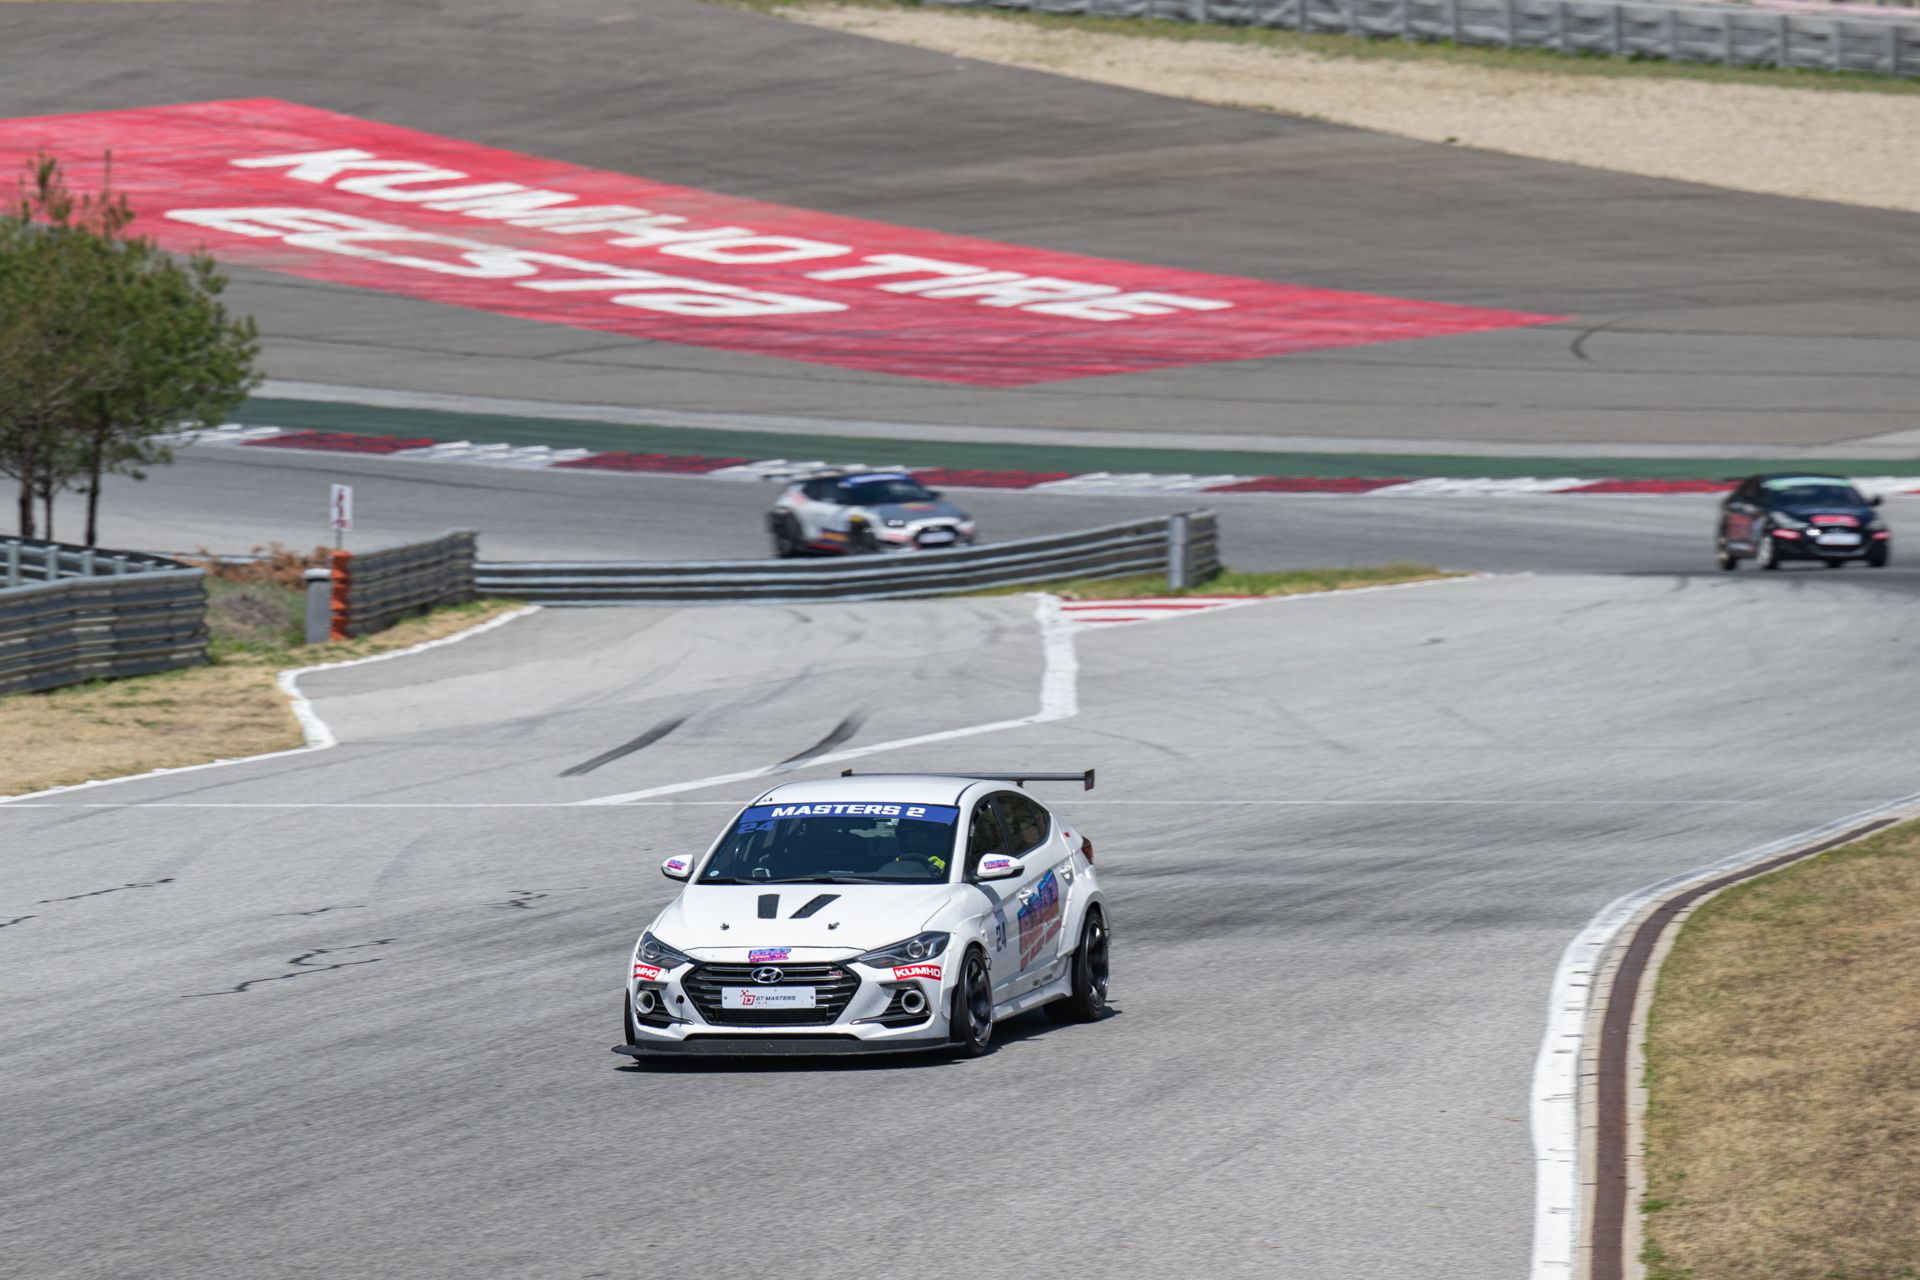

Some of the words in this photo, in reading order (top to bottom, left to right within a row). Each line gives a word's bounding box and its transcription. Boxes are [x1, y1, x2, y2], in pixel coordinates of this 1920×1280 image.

[228, 148, 853, 264] KUMHO
[804, 253, 1235, 321] TIRE
[771, 804, 902, 818] MASTERS
[906, 806, 927, 818] 2
[737, 820, 774, 834] 24
[996, 921, 1007, 952] 24
[895, 966, 941, 978] KUMHO
